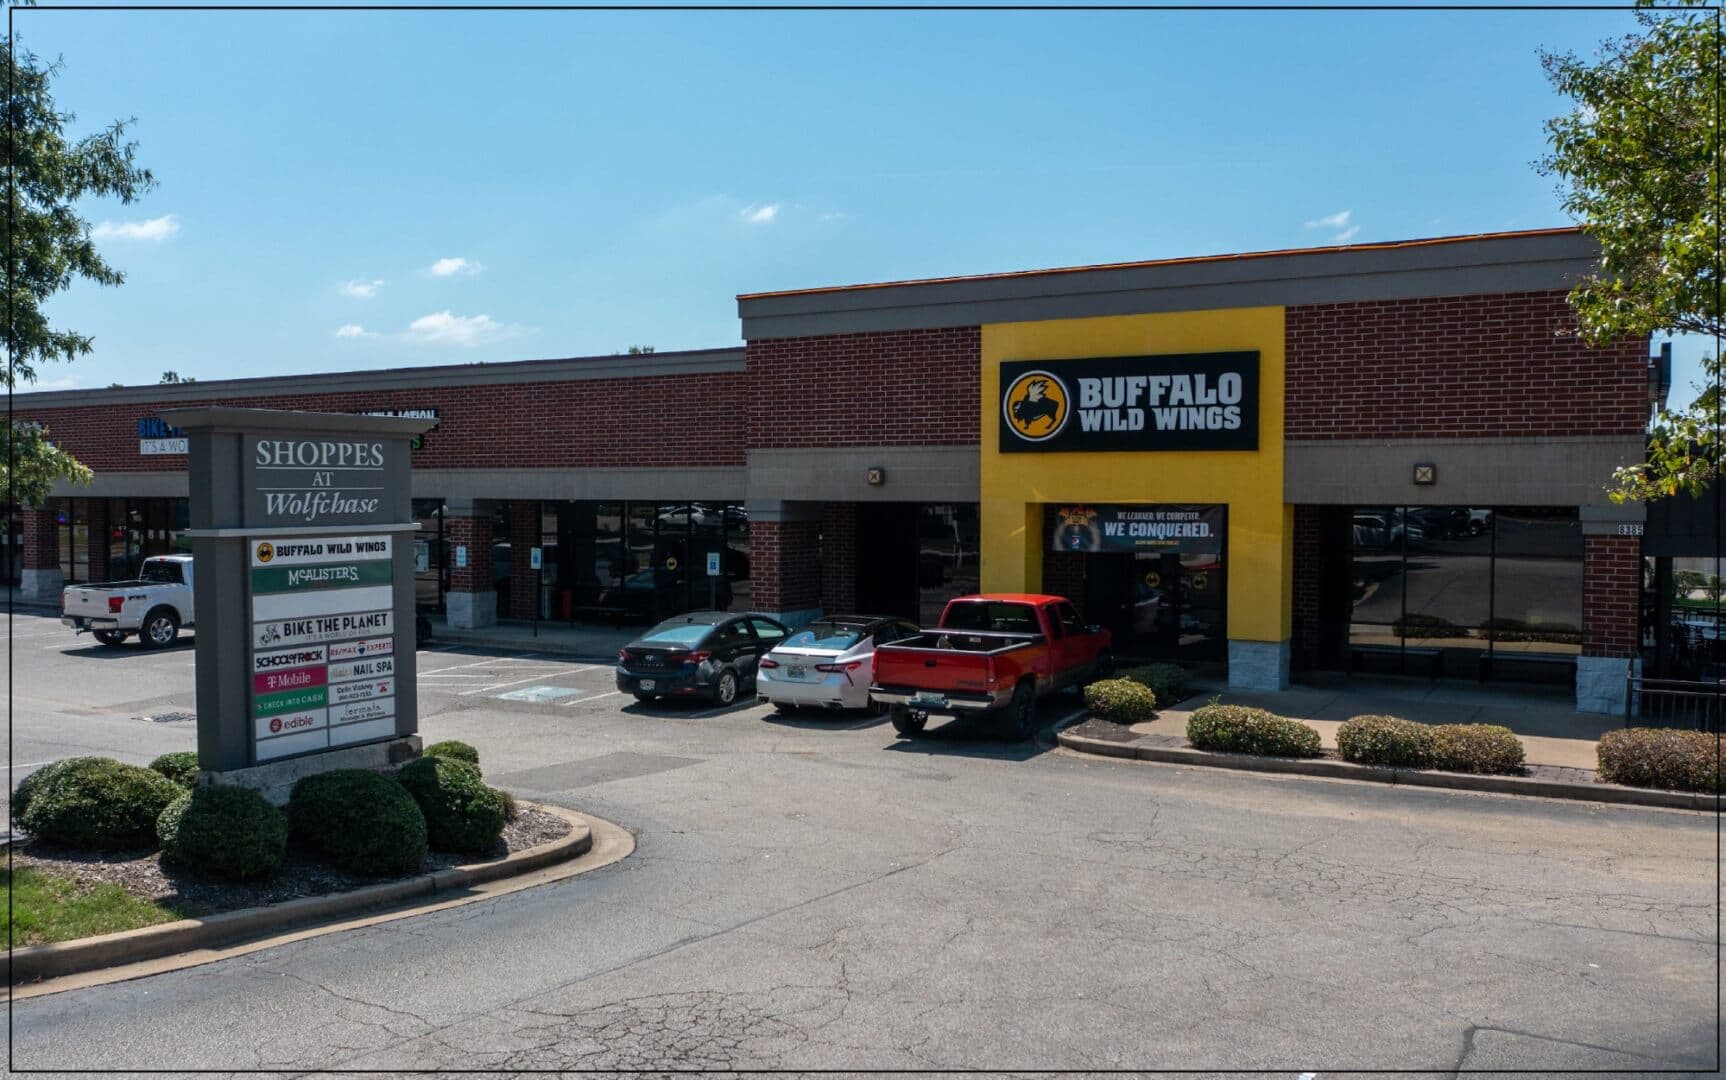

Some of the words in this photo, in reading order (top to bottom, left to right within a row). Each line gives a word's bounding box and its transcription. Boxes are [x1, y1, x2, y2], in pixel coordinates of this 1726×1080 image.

[1077, 372, 1242, 408] BUFFALO
[1077, 408, 1145, 432] WILD
[1152, 405, 1241, 431] WINGS
[256, 440, 384, 466] SHOPPES
[312, 471, 334, 486] AT
[264, 491, 379, 521] Wolfchase
[1117, 511, 1126, 520] WE
[1156, 511, 1165, 520] WE
[1104, 522, 1126, 537] WE
[1129, 522, 1214, 540] CONQUERED.
[276, 544, 323, 557] BUFFALO
[327, 543, 353, 554] WILD
[355, 541, 387, 553] WINGS
[283, 621, 313, 637] BIKE
[316, 617, 340, 633] THE
[343, 613, 388, 630] PLANET
[353, 663, 374, 677] NAIL
[377, 661, 392, 673] SPA
[263, 699, 284, 711] CHECK
[301, 693, 324, 704] CASH
[283, 716, 314, 730] edible
